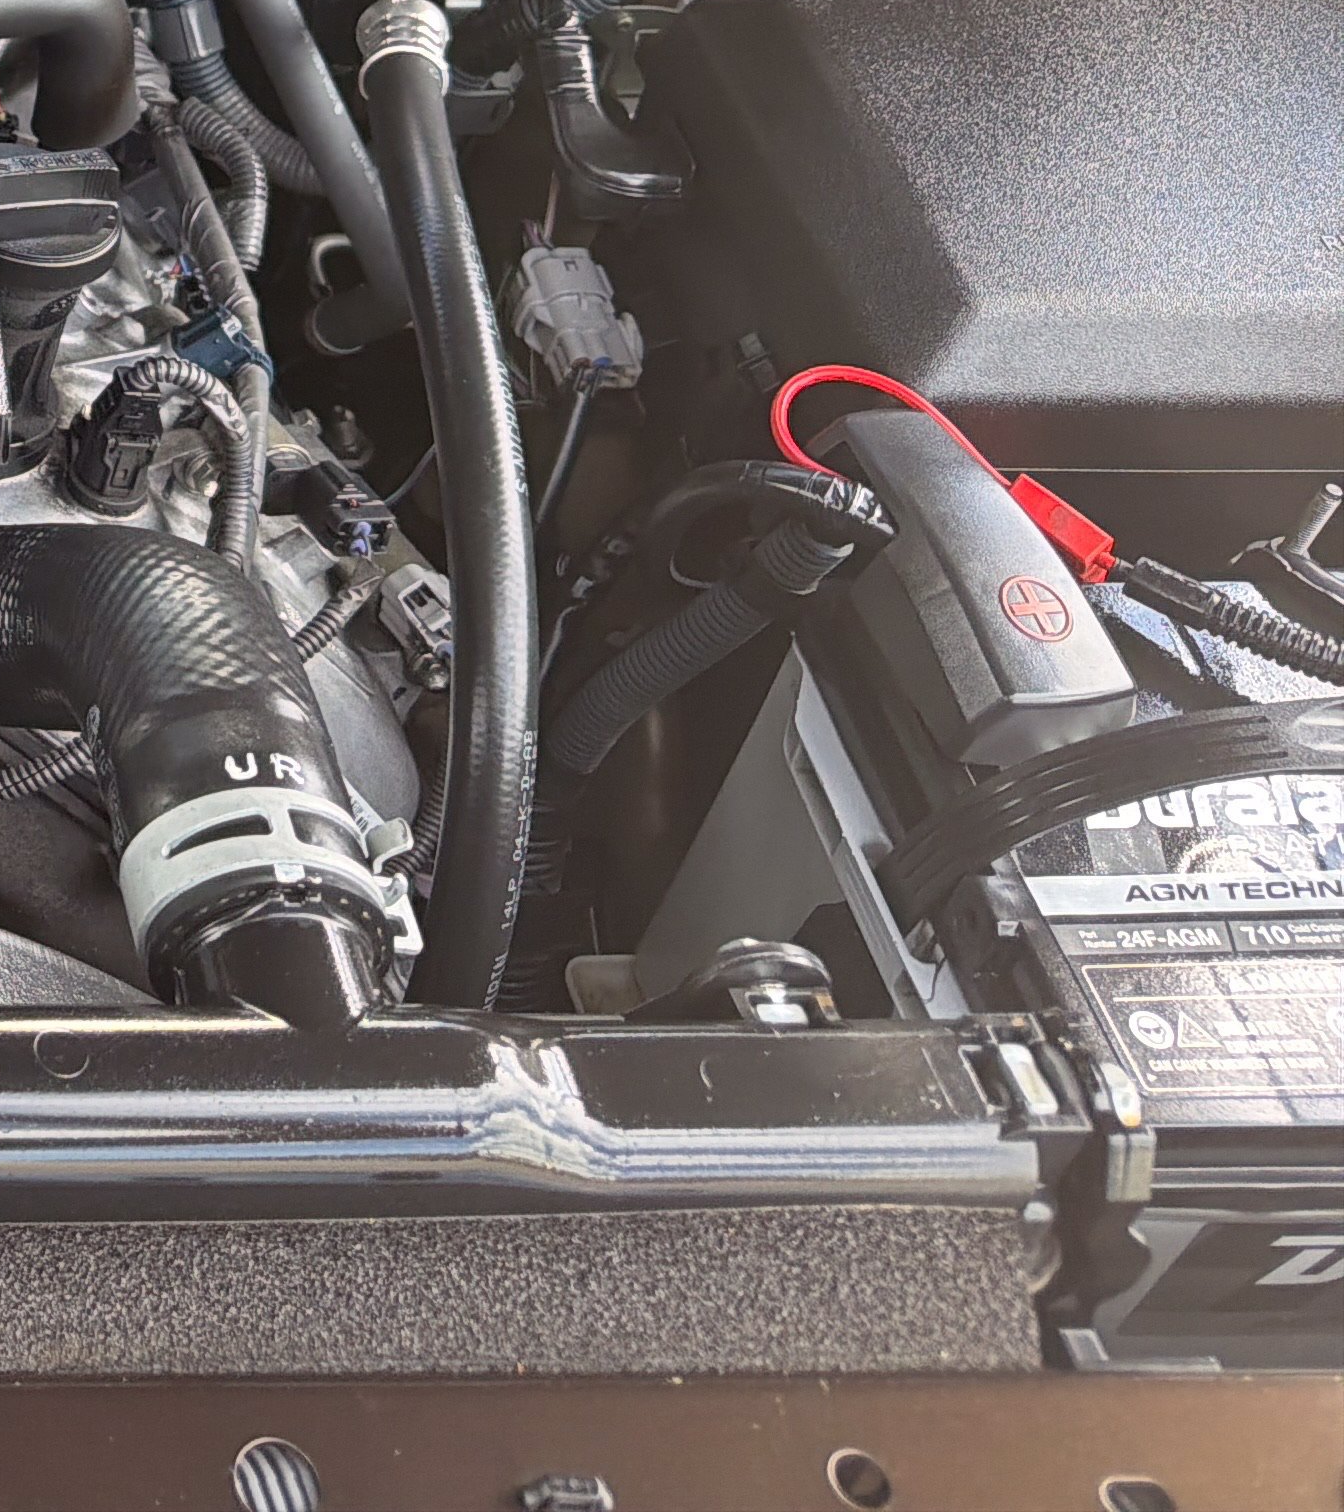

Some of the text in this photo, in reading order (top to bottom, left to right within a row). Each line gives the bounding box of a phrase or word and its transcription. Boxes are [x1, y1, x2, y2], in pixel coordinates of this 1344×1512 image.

[1125, 882, 1210, 903] AGM
[1116, 927, 1222, 949] 24F-AGM
[1240, 925, 1292, 946] 710
